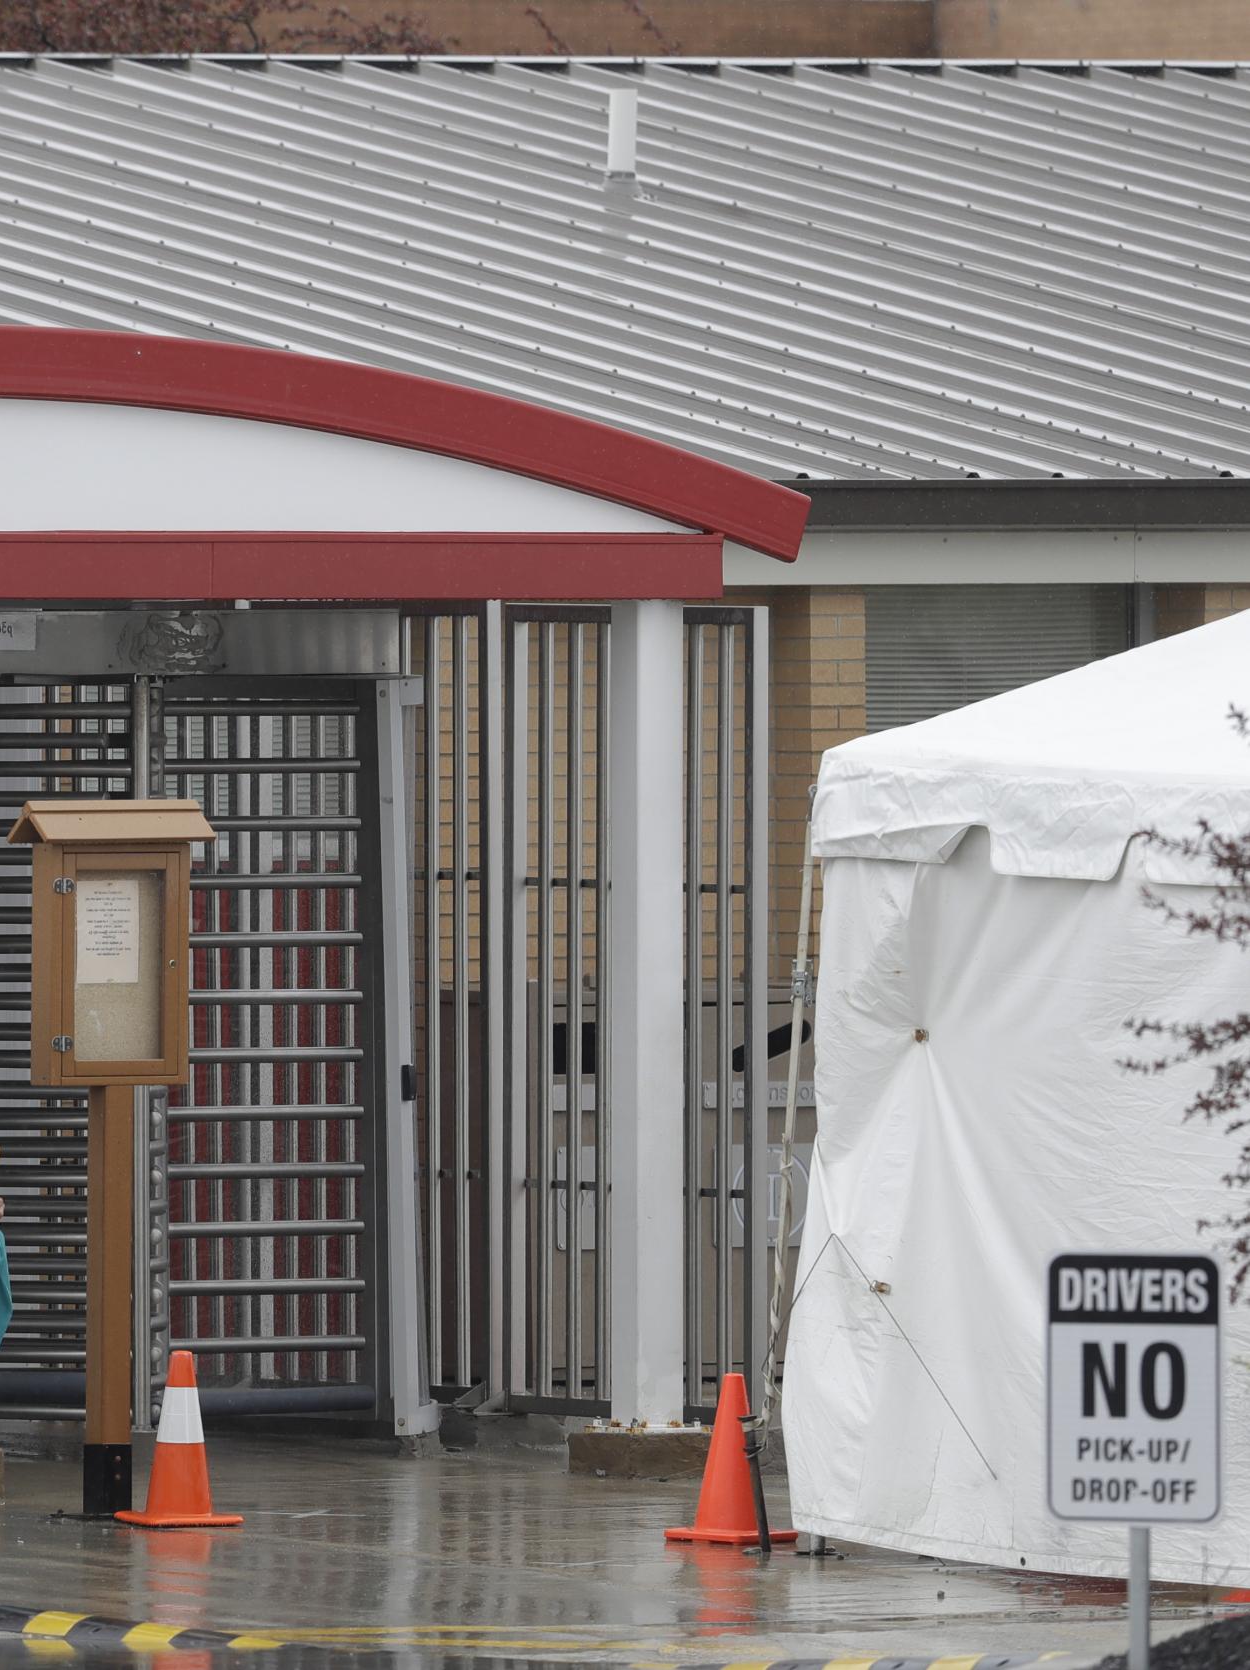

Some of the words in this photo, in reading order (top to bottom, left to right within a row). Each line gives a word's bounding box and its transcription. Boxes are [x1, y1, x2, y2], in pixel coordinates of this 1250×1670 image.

[1058, 1267, 1210, 1314] DRIVERS
[1082, 1341, 1186, 1421] NO
[1077, 1437, 1191, 1463] PICK-UP/
[1072, 1478, 1197, 1504] DROP-OFF
